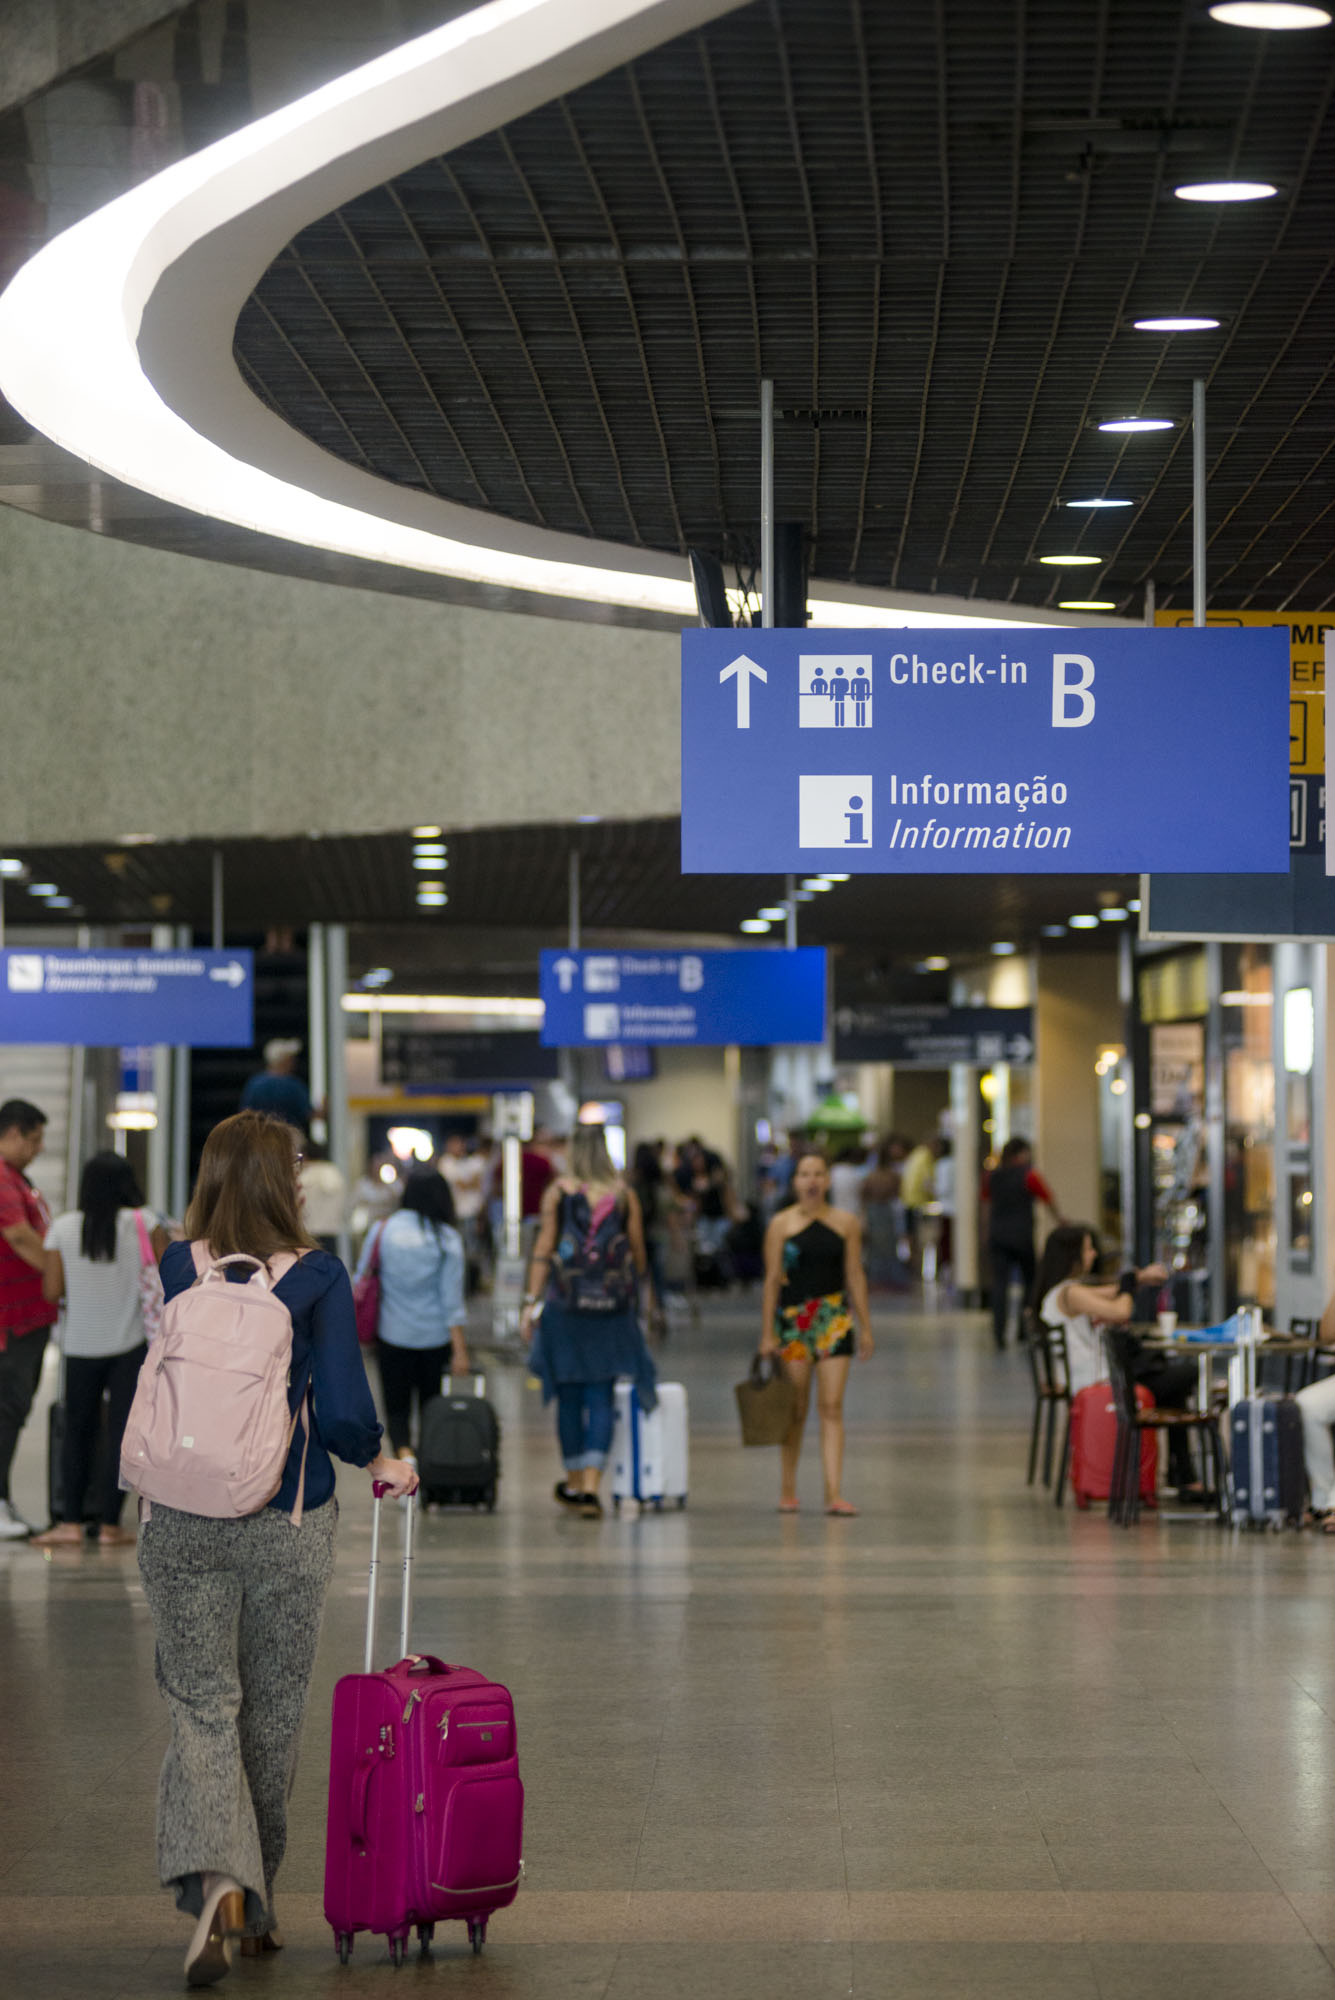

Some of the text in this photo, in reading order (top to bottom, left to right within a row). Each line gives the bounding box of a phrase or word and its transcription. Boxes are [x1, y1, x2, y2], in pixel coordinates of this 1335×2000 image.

[889, 653, 1096, 728] Check-in B
[890, 774, 1068, 813] Informação
[889, 818, 1072, 849] Information
